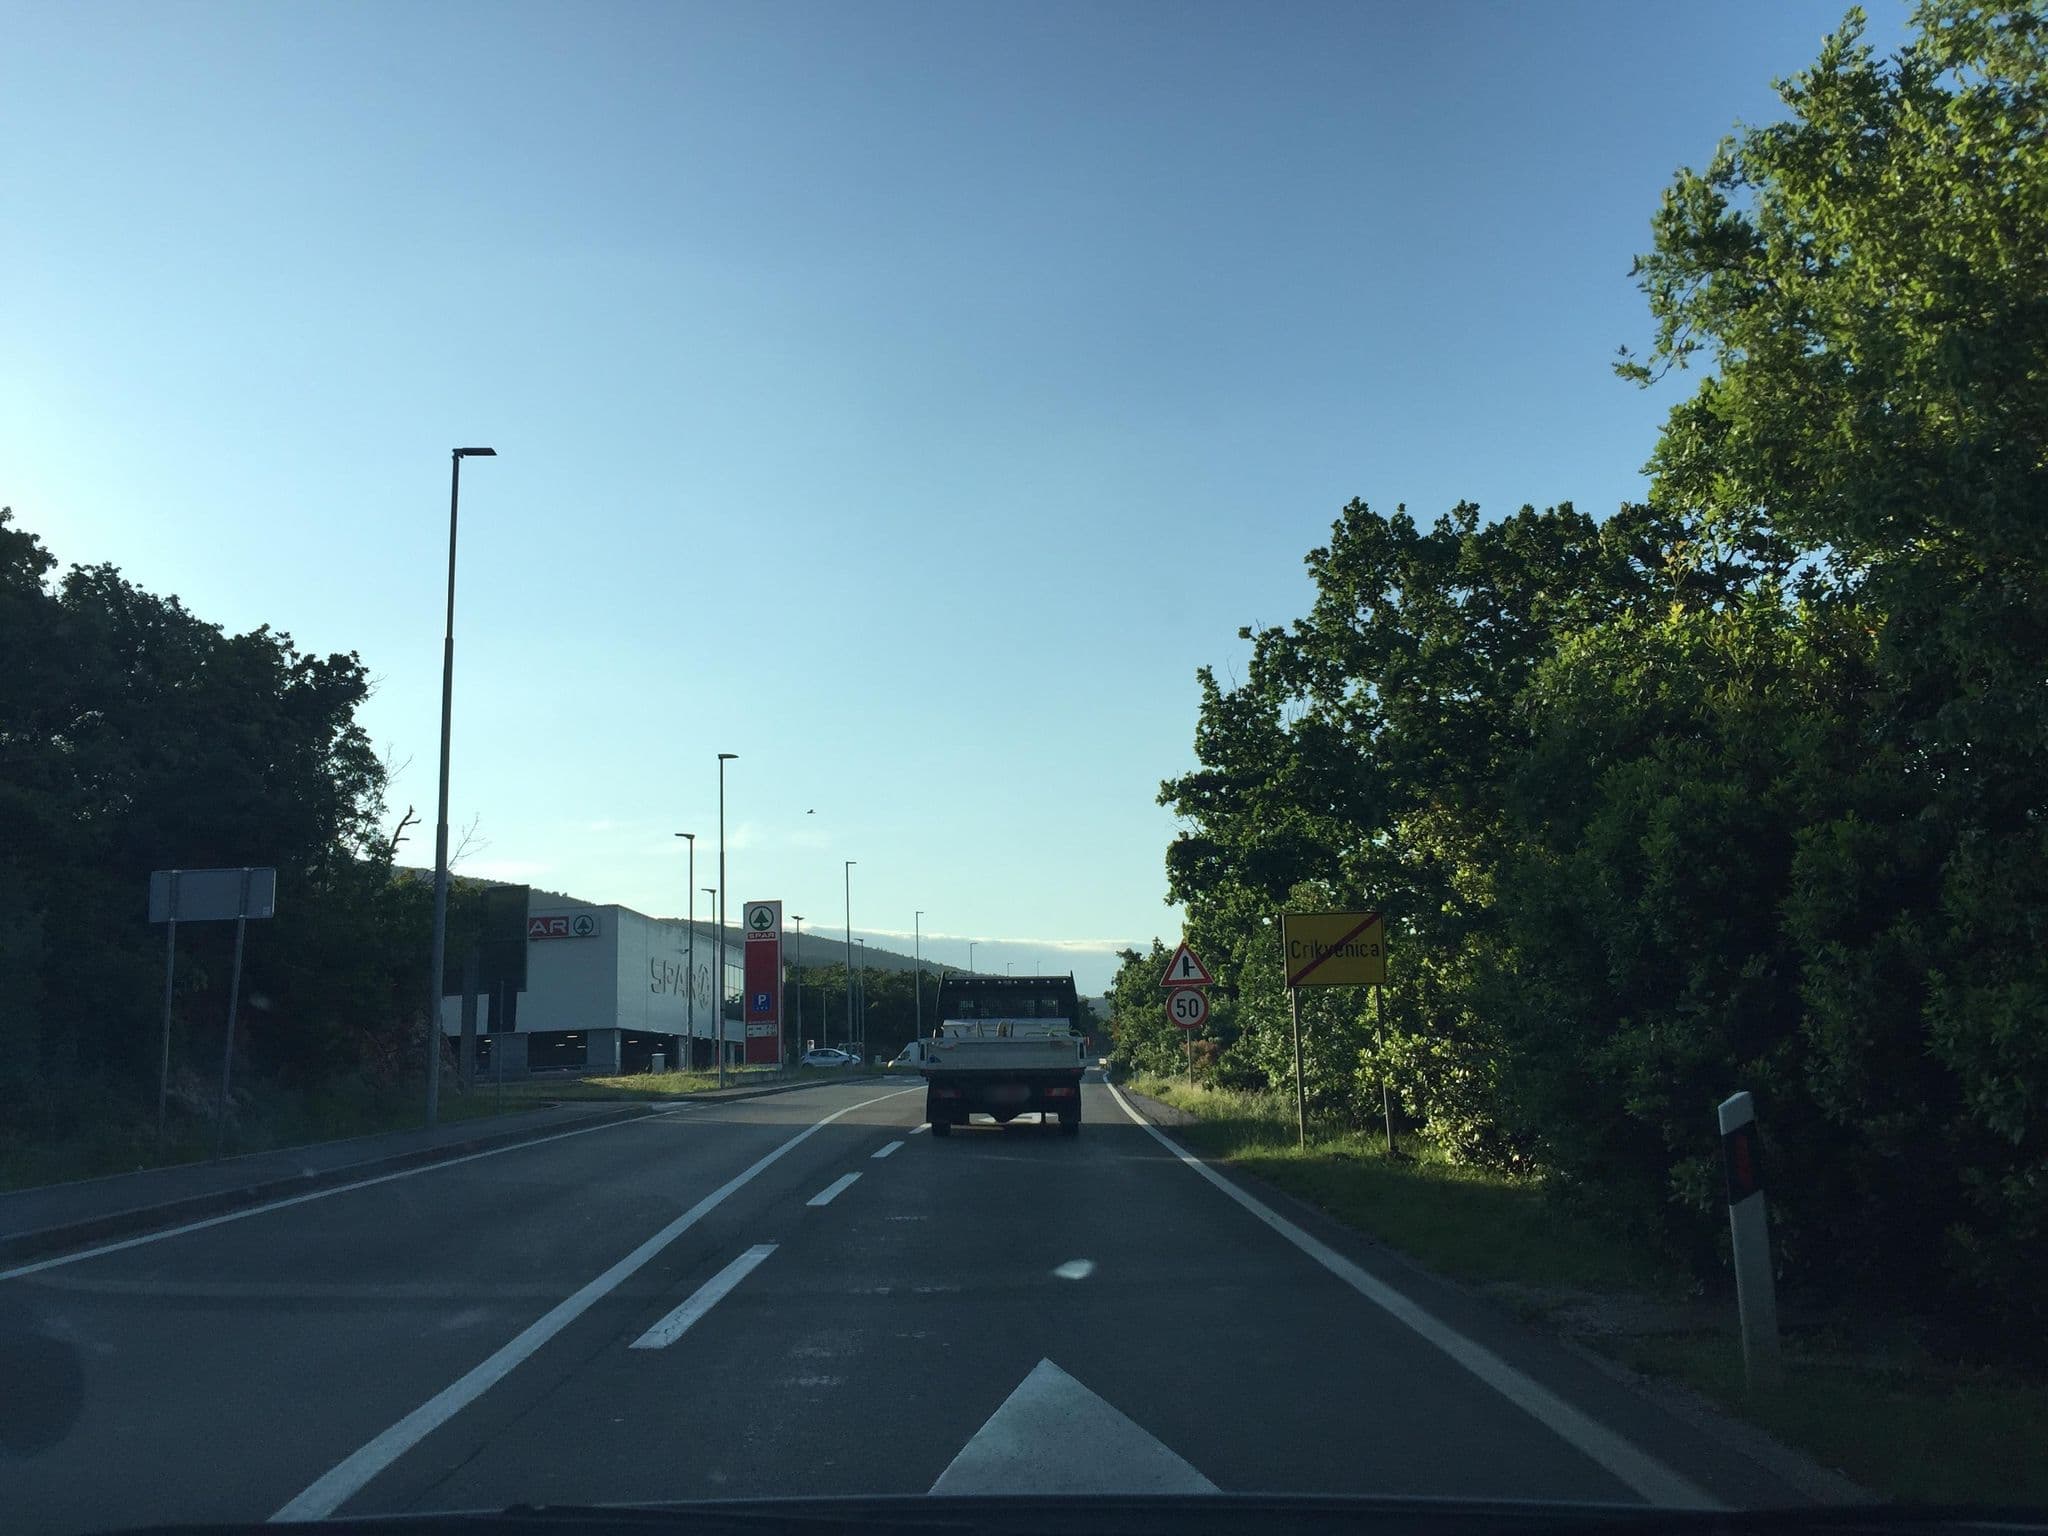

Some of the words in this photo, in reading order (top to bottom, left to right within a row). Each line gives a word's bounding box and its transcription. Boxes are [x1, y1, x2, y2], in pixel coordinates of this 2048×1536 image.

[529, 919, 568, 935] AR
[748, 932, 776, 940] SPAR
[1290, 940, 1380, 959] Crikvenica
[758, 994, 767, 1006] P
[1176, 998, 1199, 1018] 50
